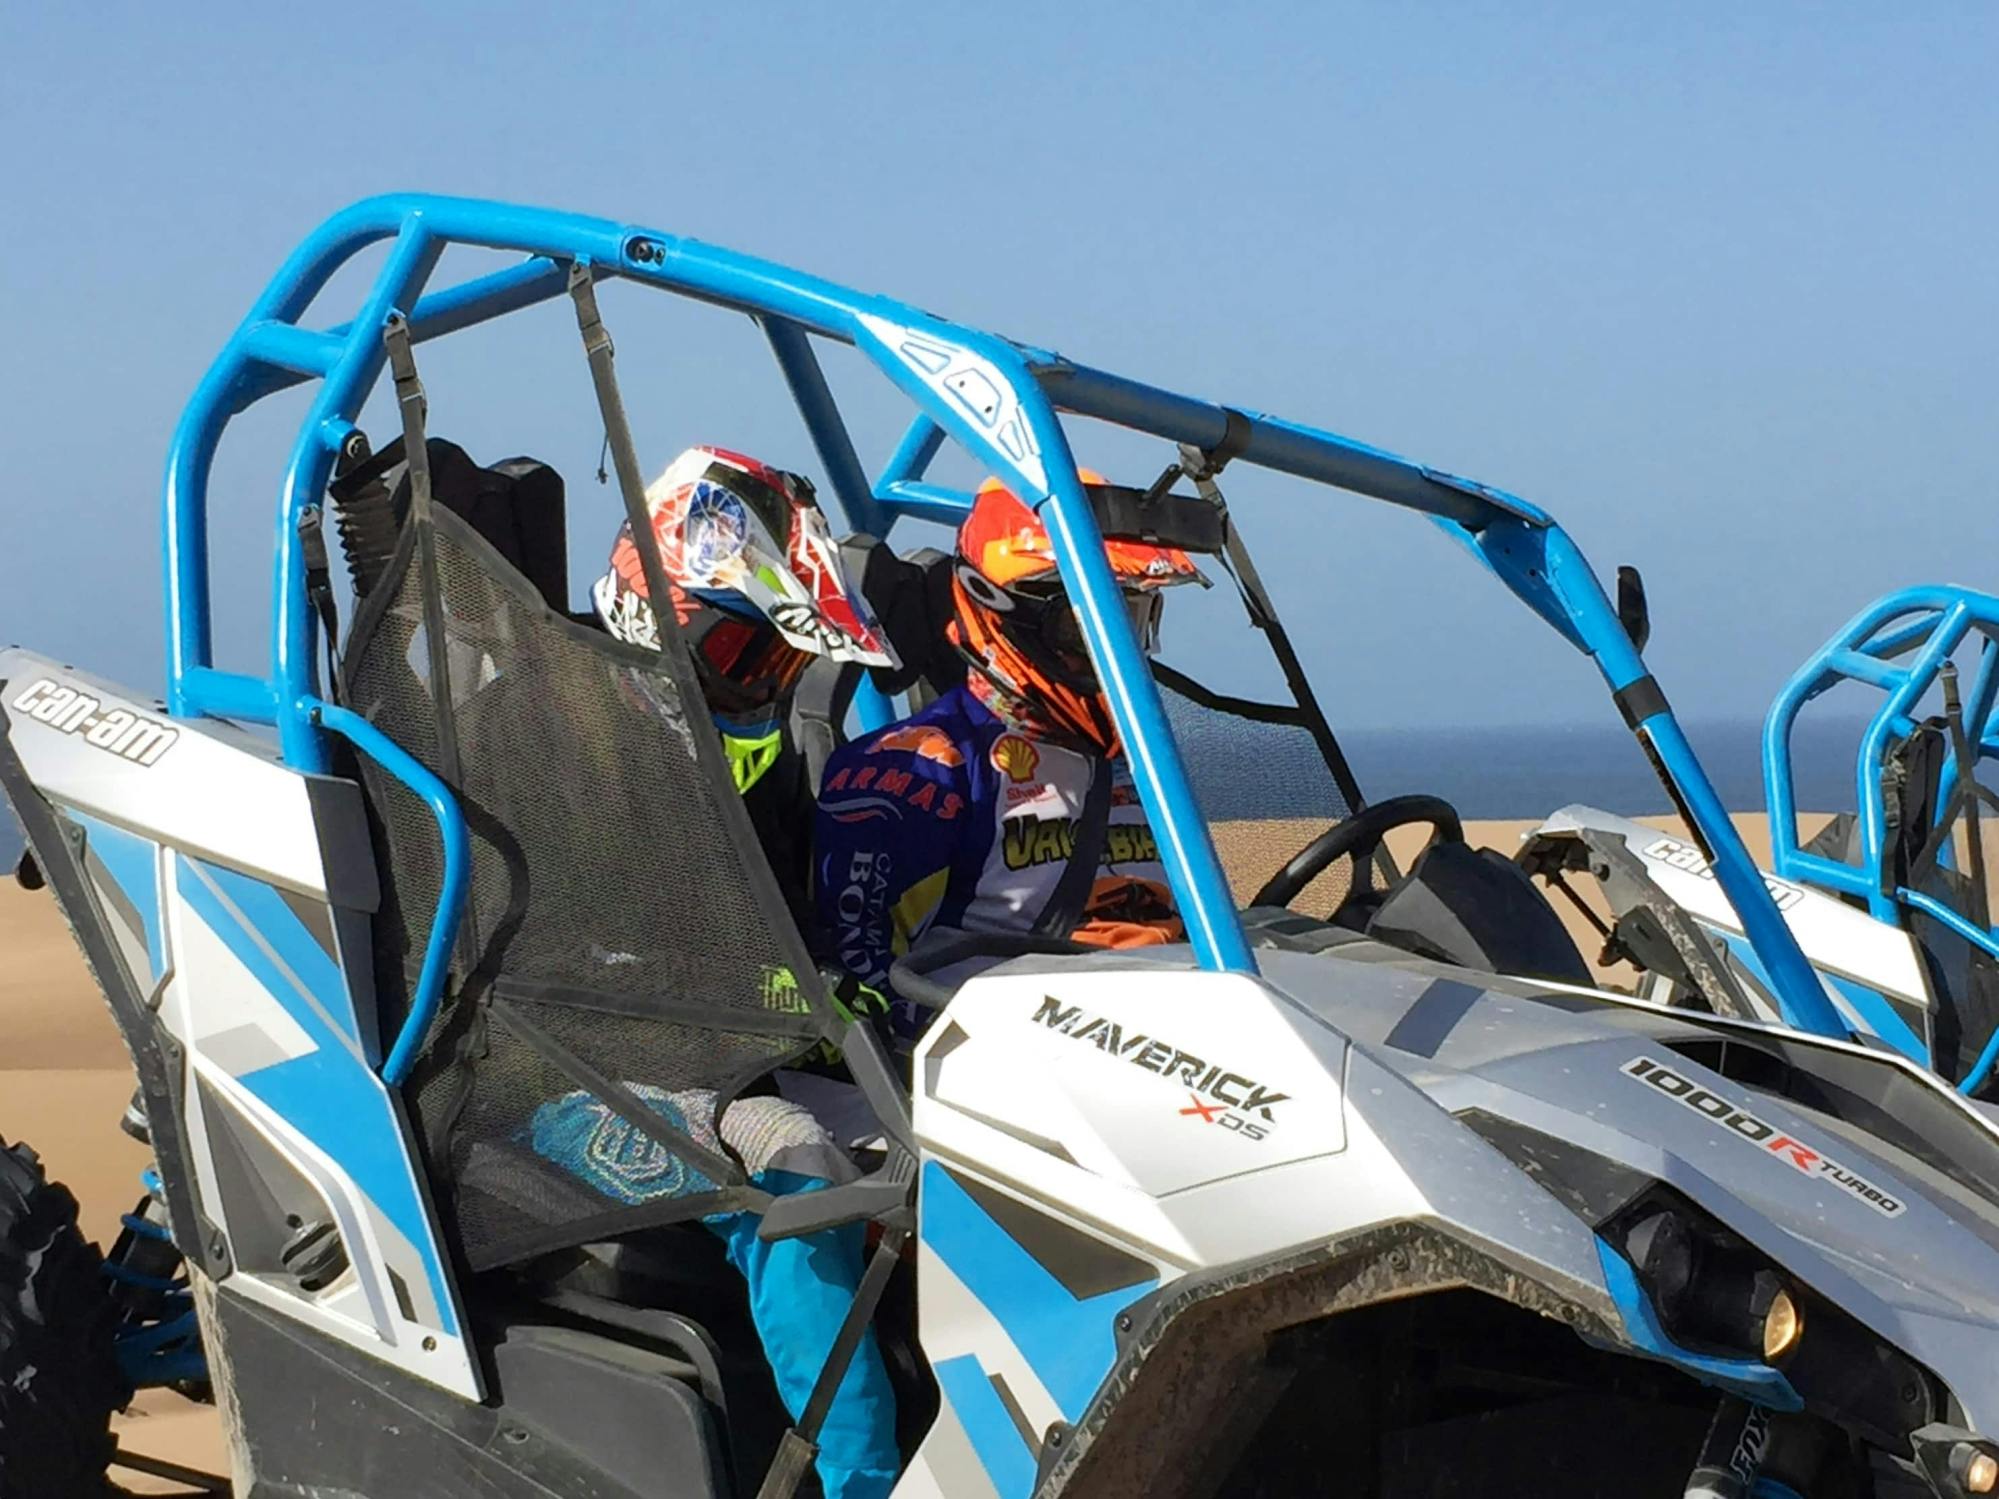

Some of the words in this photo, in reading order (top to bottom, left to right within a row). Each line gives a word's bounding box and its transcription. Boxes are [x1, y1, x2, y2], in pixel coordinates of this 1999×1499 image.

[11, 677, 181, 768] can-am
[826, 766, 964, 819] ARMAS
[1643, 839, 1805, 912] canm
[1031, 994, 1292, 1124] MAVERICK
[1628, 1058, 1821, 1173] 1000R
[1820, 1158, 1899, 1213] TURBO
